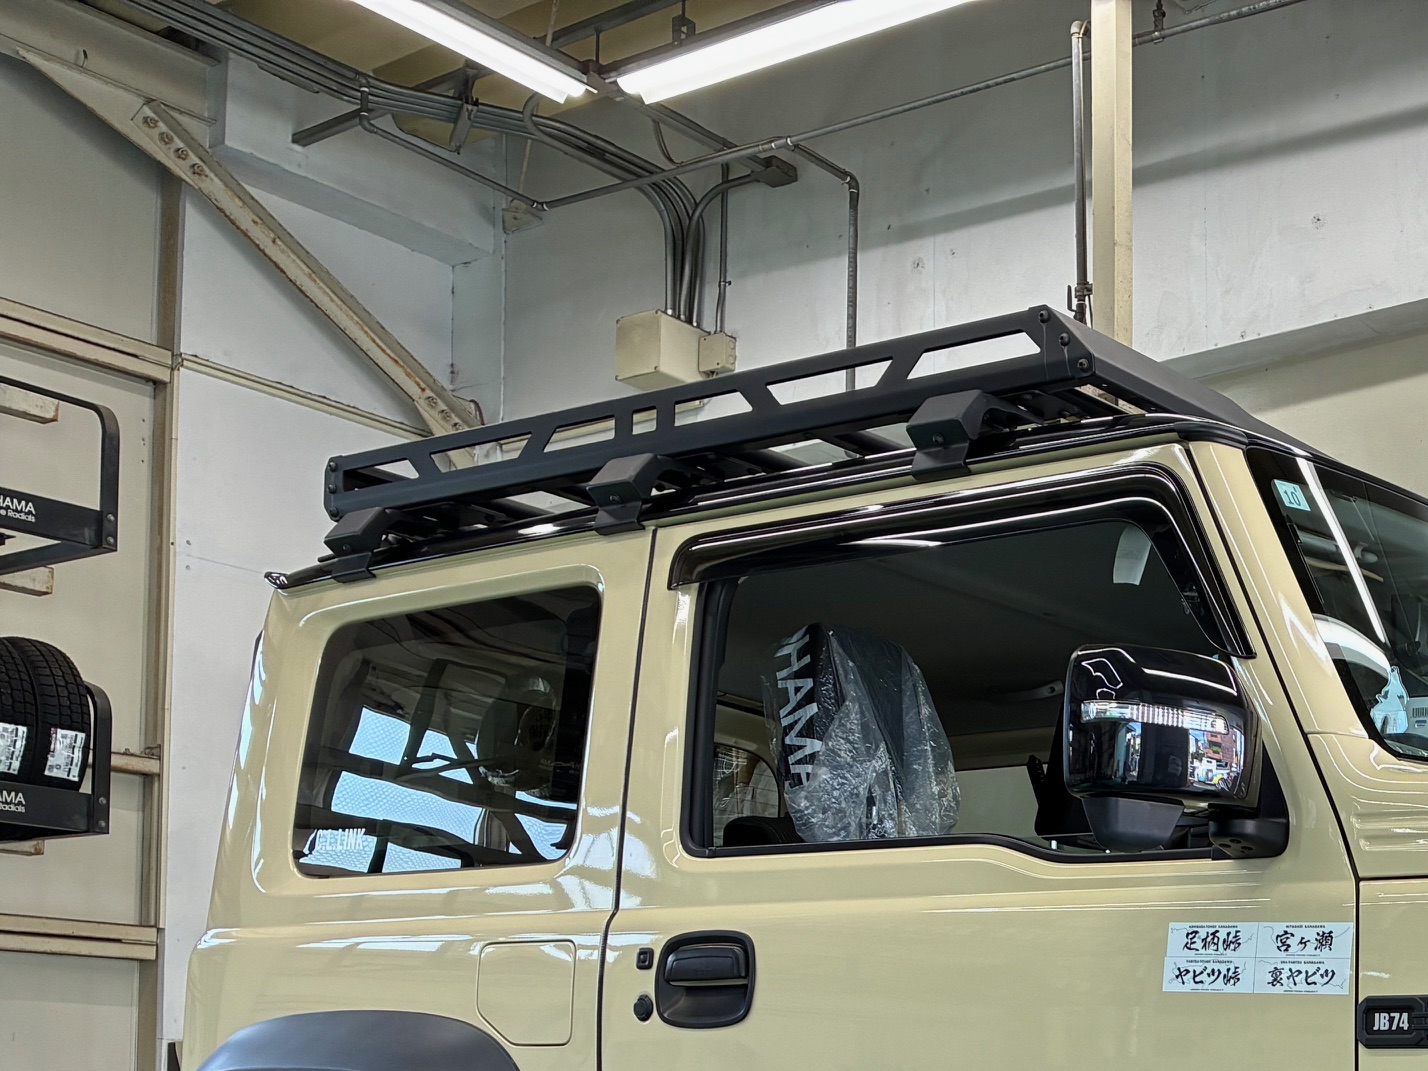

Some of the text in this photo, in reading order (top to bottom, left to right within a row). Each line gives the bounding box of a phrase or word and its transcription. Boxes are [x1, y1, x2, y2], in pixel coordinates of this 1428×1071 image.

[1182, 929, 1242, 952] 足柄峠
[1175, 965, 1241, 987] ヤビツ峠
[1266, 966, 1336, 987] 裏ヤビツ
[1372, 1012, 1410, 1031] JB74
